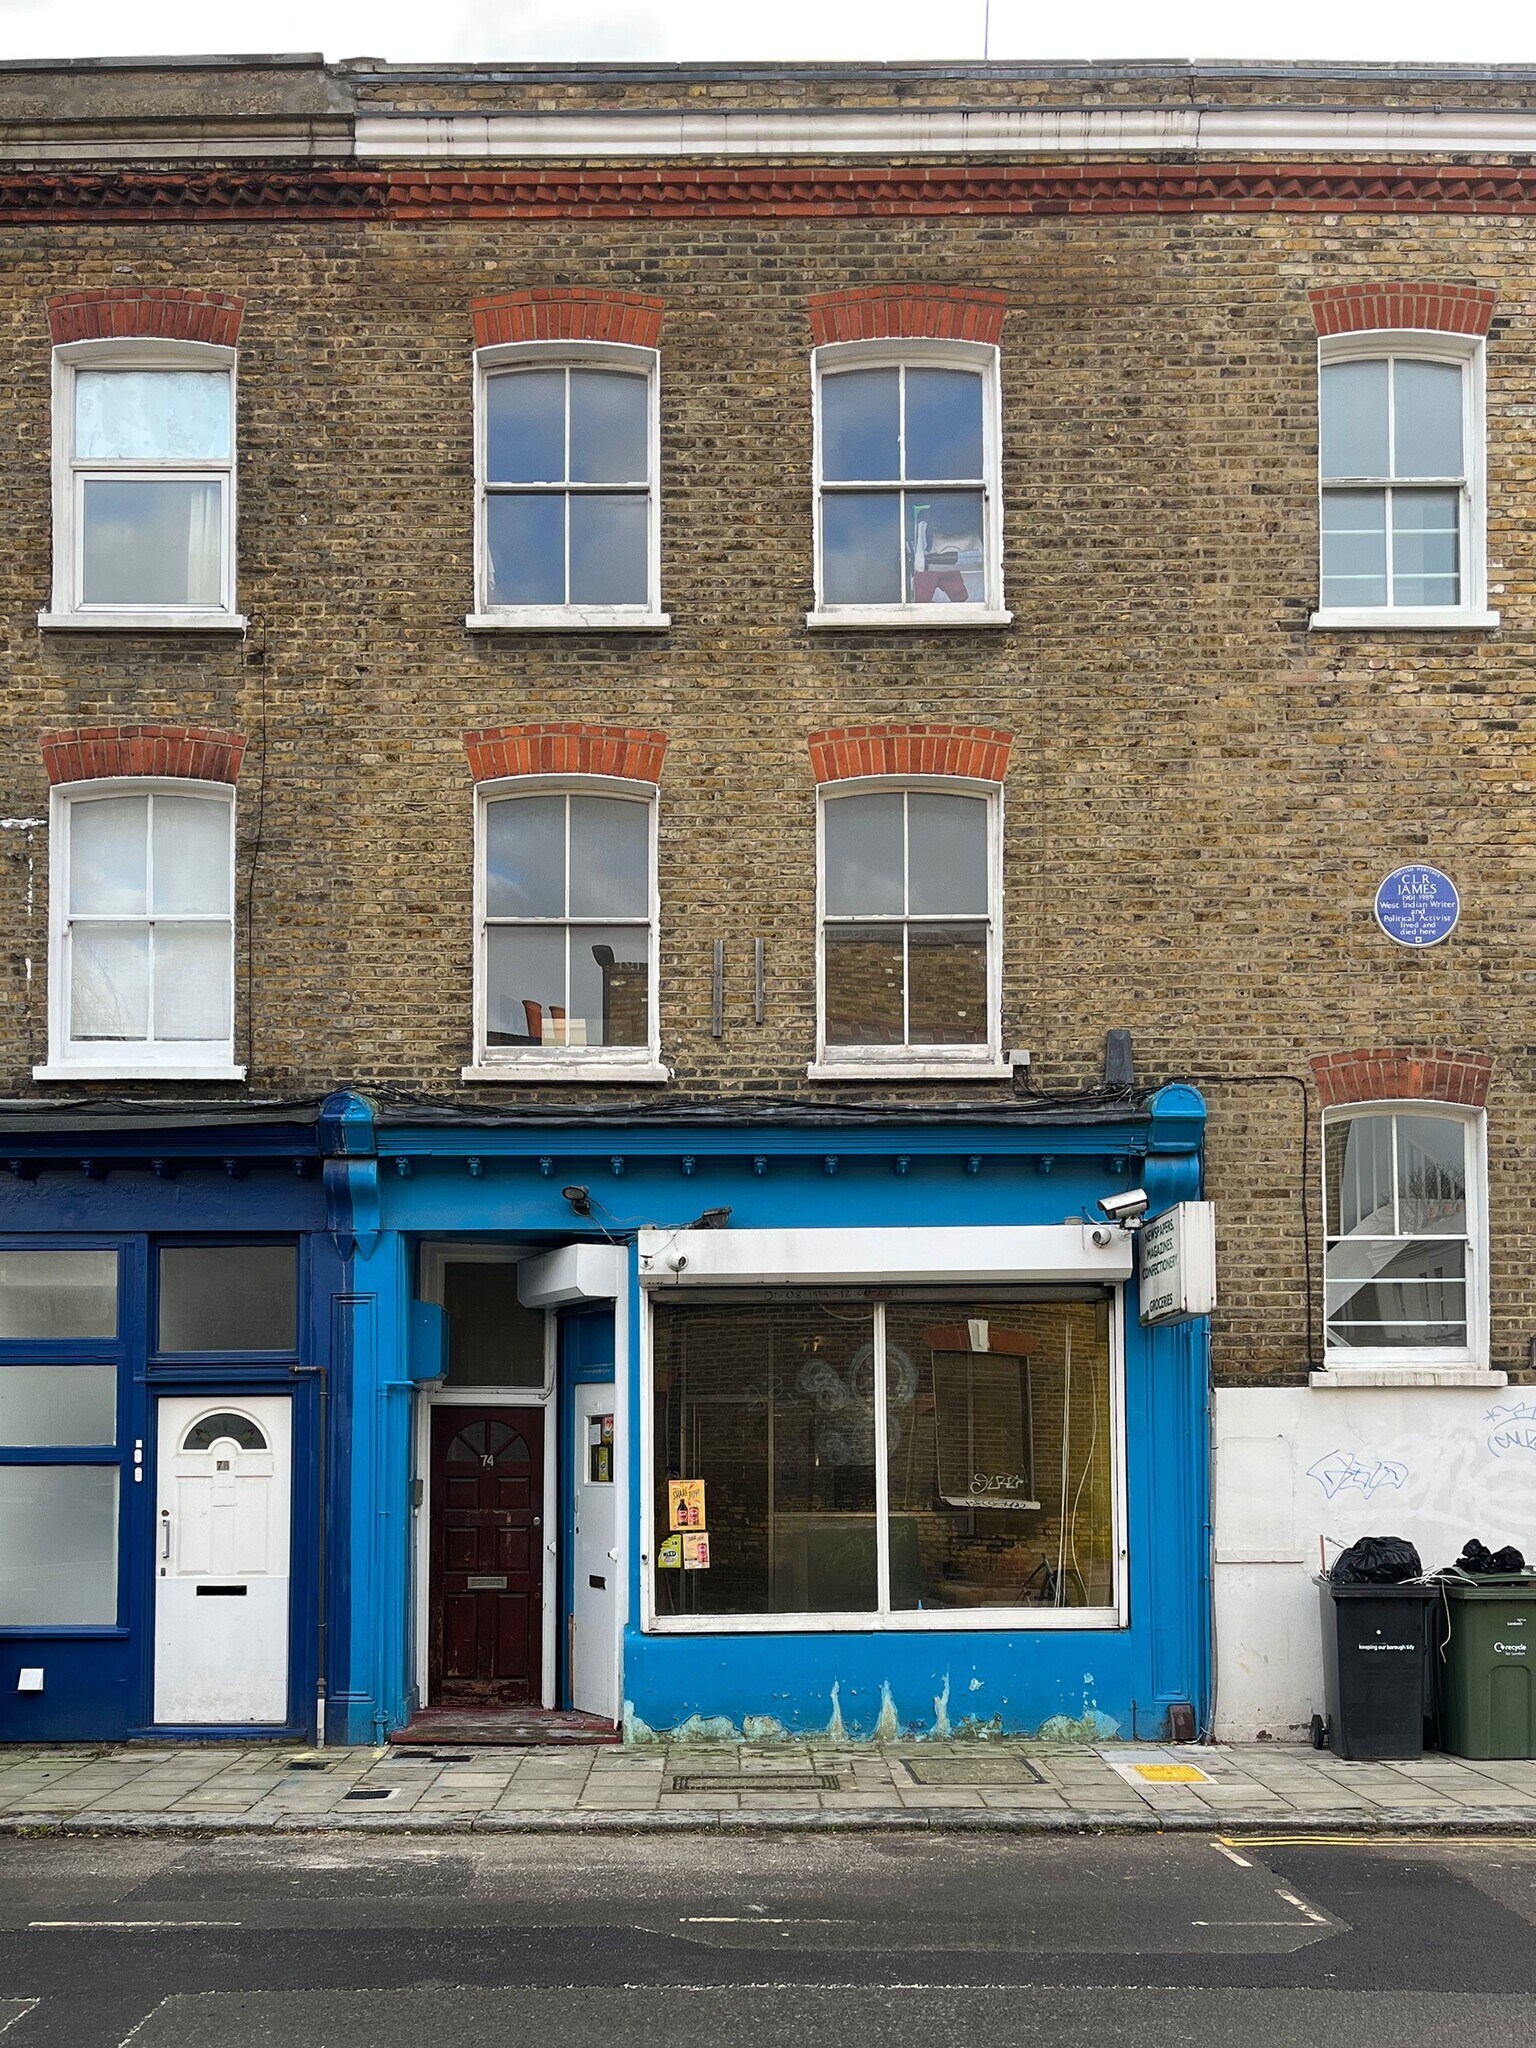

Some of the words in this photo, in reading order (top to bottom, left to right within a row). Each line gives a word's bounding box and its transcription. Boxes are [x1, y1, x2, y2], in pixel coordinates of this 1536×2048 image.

[1392, 867, 1414, 879] ENGLISH
[1416, 867, 1441, 878] HERITAGE
[1397, 883, 1437, 895] JAMES
[1383, 914, 1415, 922] Political
[1149, 1293, 1173, 1313] GROCERIES
[480, 1454, 495, 1467] 74
[1505, 1643, 1527, 1652] recycle
